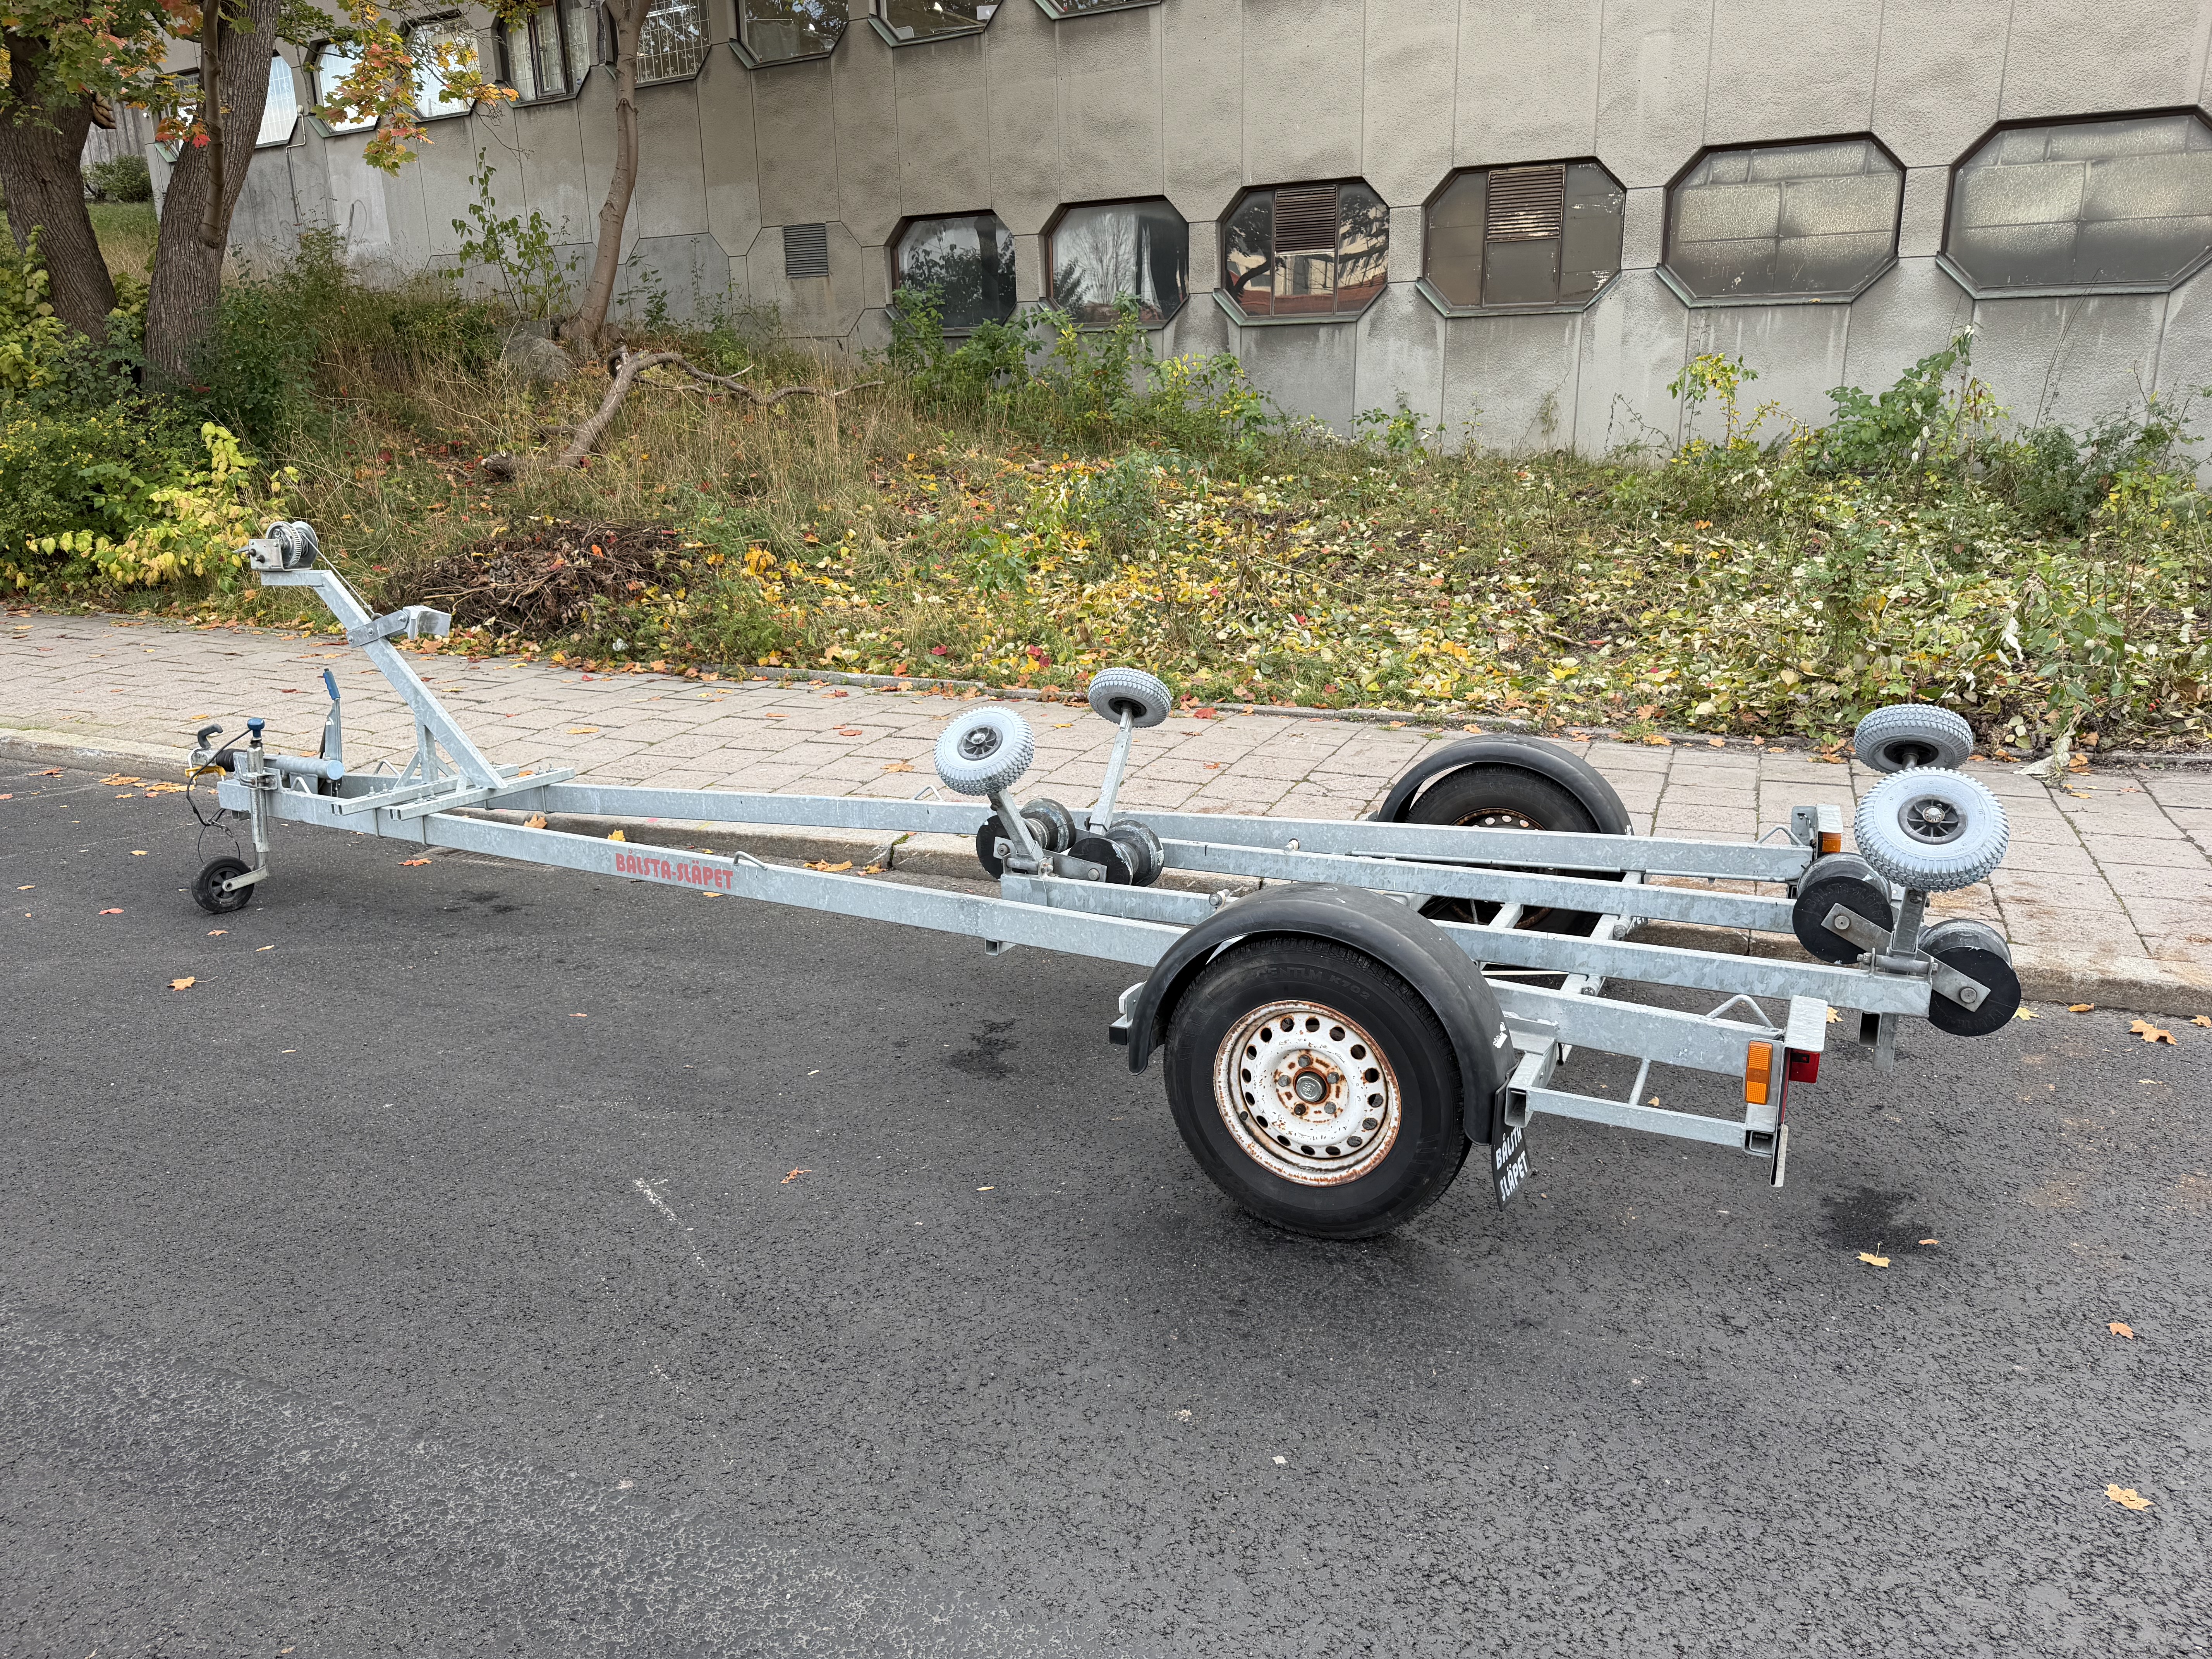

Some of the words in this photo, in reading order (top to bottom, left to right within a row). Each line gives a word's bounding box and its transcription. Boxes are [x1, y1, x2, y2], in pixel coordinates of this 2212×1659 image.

[615, 849, 733, 890] BÅLSTA-SLÄPET
[1256, 967, 1322, 982] CENTUM
[1329, 975, 1370, 1000] K702
[1496, 1127, 1522, 1170] BÅLSTA
[1499, 1150, 1528, 1201] SLÄPET
